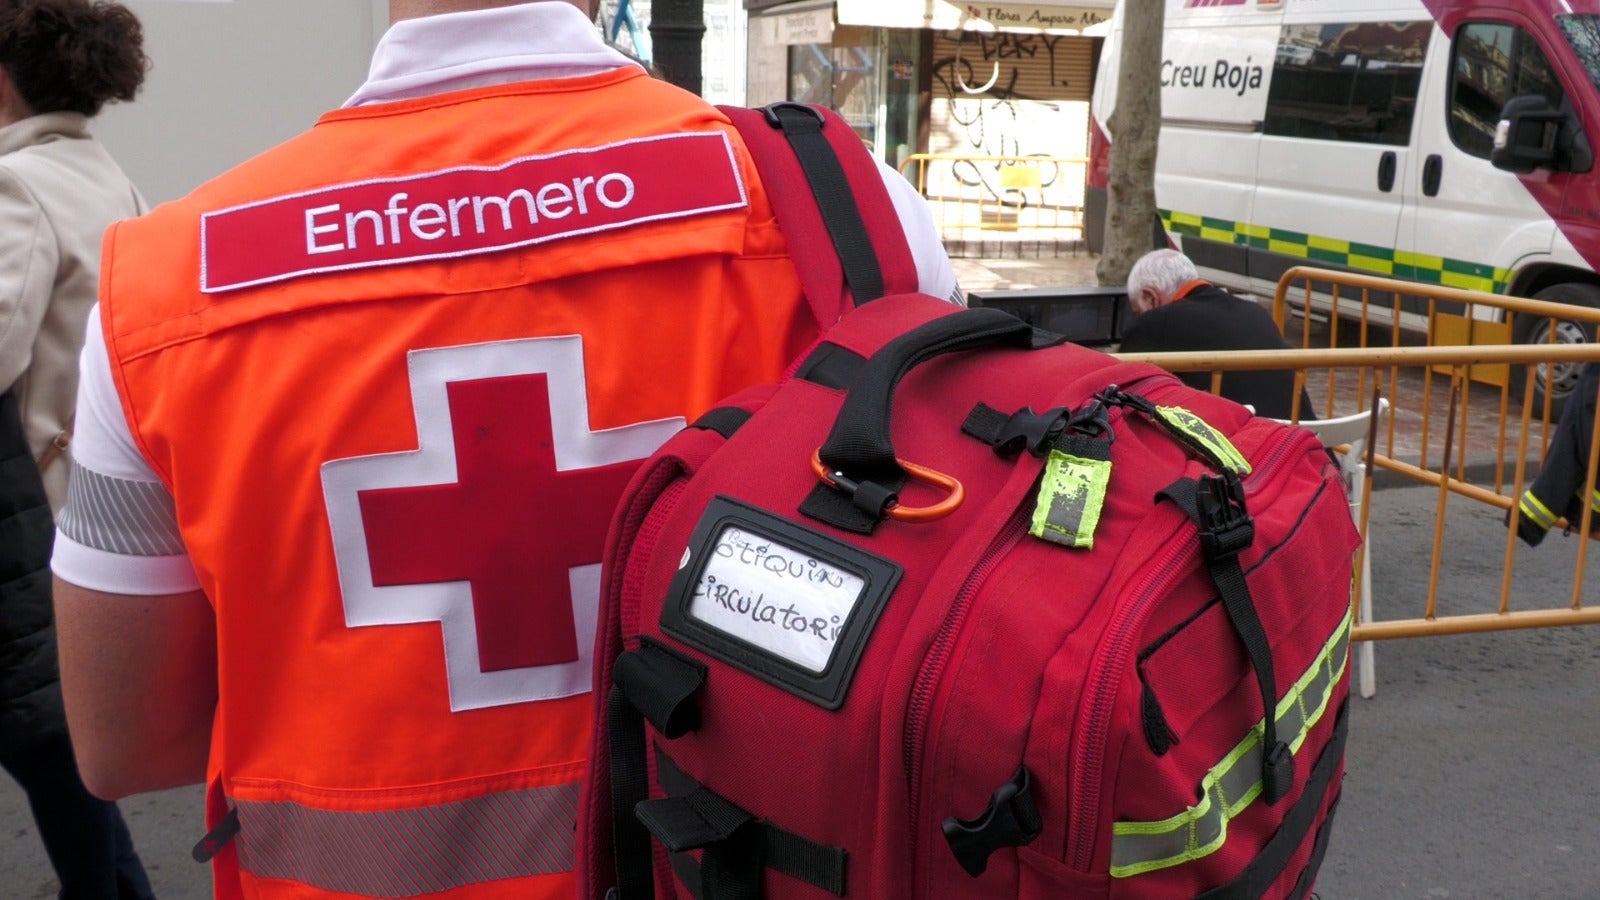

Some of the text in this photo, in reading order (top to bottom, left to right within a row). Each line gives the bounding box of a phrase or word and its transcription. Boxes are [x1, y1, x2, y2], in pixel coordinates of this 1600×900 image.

[986, 7, 1021, 21] Flores
[1026, 9, 1076, 27] Amparo
[1160, 55, 1263, 96] Creu Roja
[306, 171, 634, 256] Enfermero
